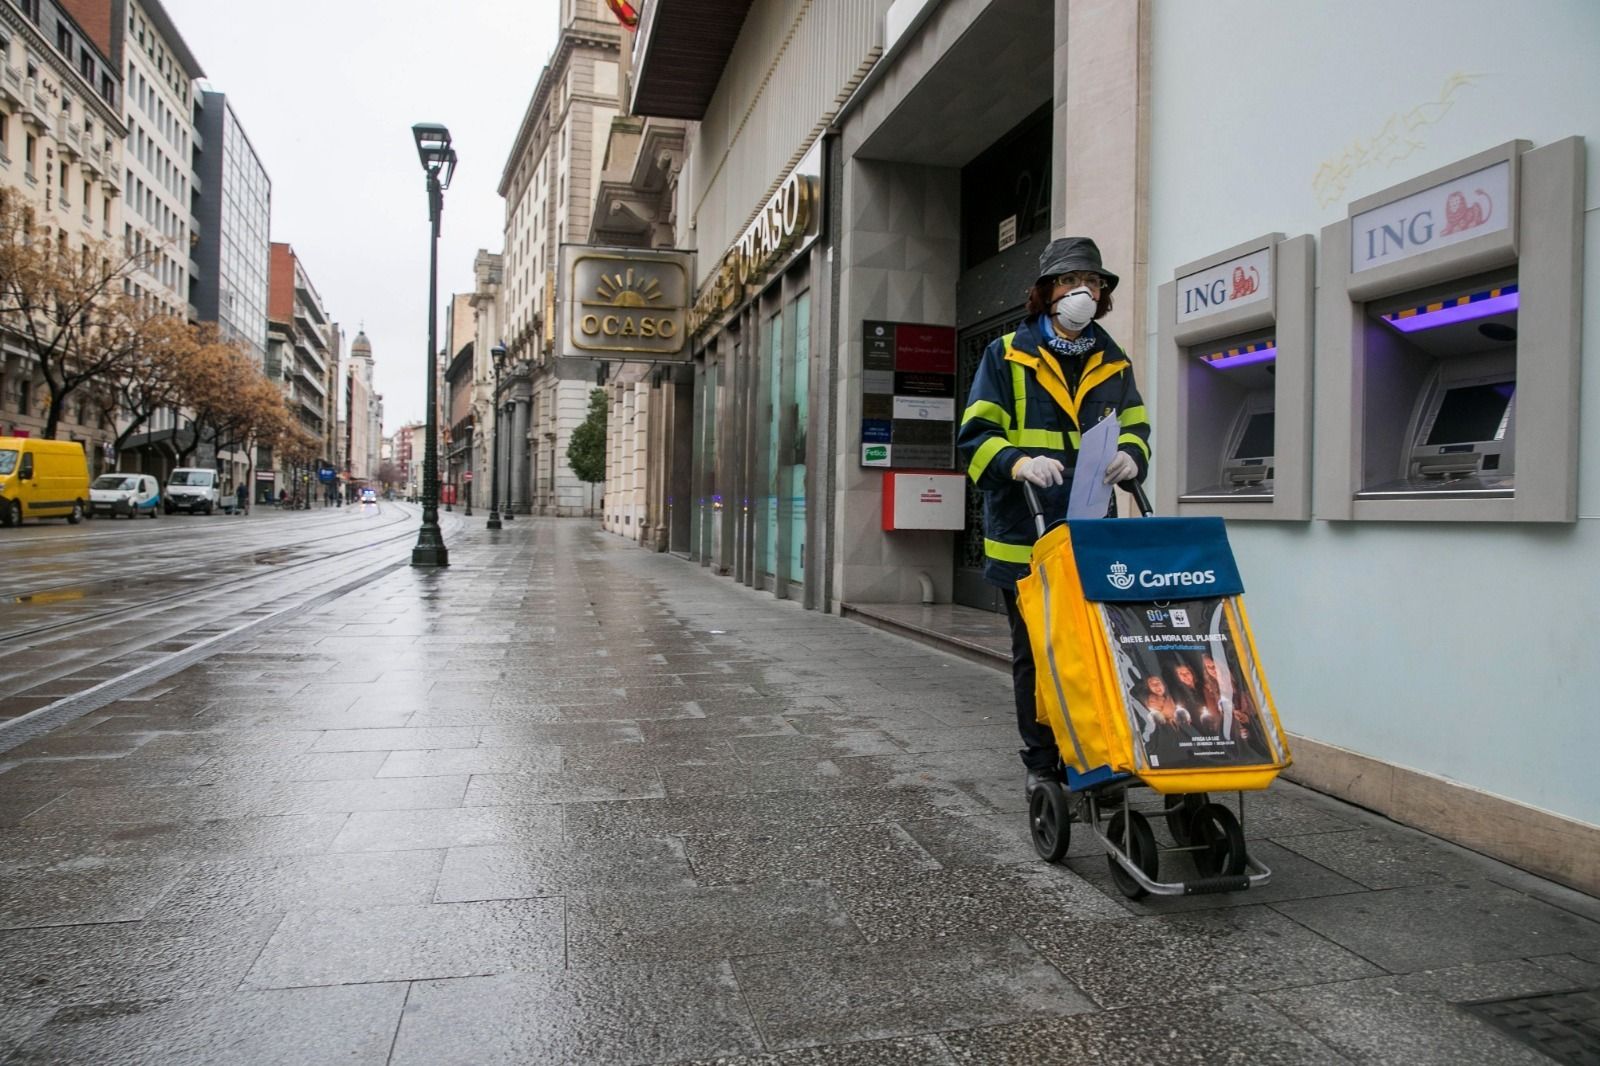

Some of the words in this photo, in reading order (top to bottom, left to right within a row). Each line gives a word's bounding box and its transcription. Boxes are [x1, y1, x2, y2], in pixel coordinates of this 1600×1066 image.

[738, 172, 801, 285] OCASO
[1365, 210, 1435, 261] ING
[1184, 279, 1227, 315] ING
[580, 313, 677, 339] OCASO
[1139, 569, 1216, 588] Correos
[1144, 635, 1151, 643] A
[1151, 634, 1162, 643] LA
[1162, 634, 1181, 642] HORA
[1181, 634, 1196, 642] DEL
[1196, 633, 1228, 642] PLANETA
